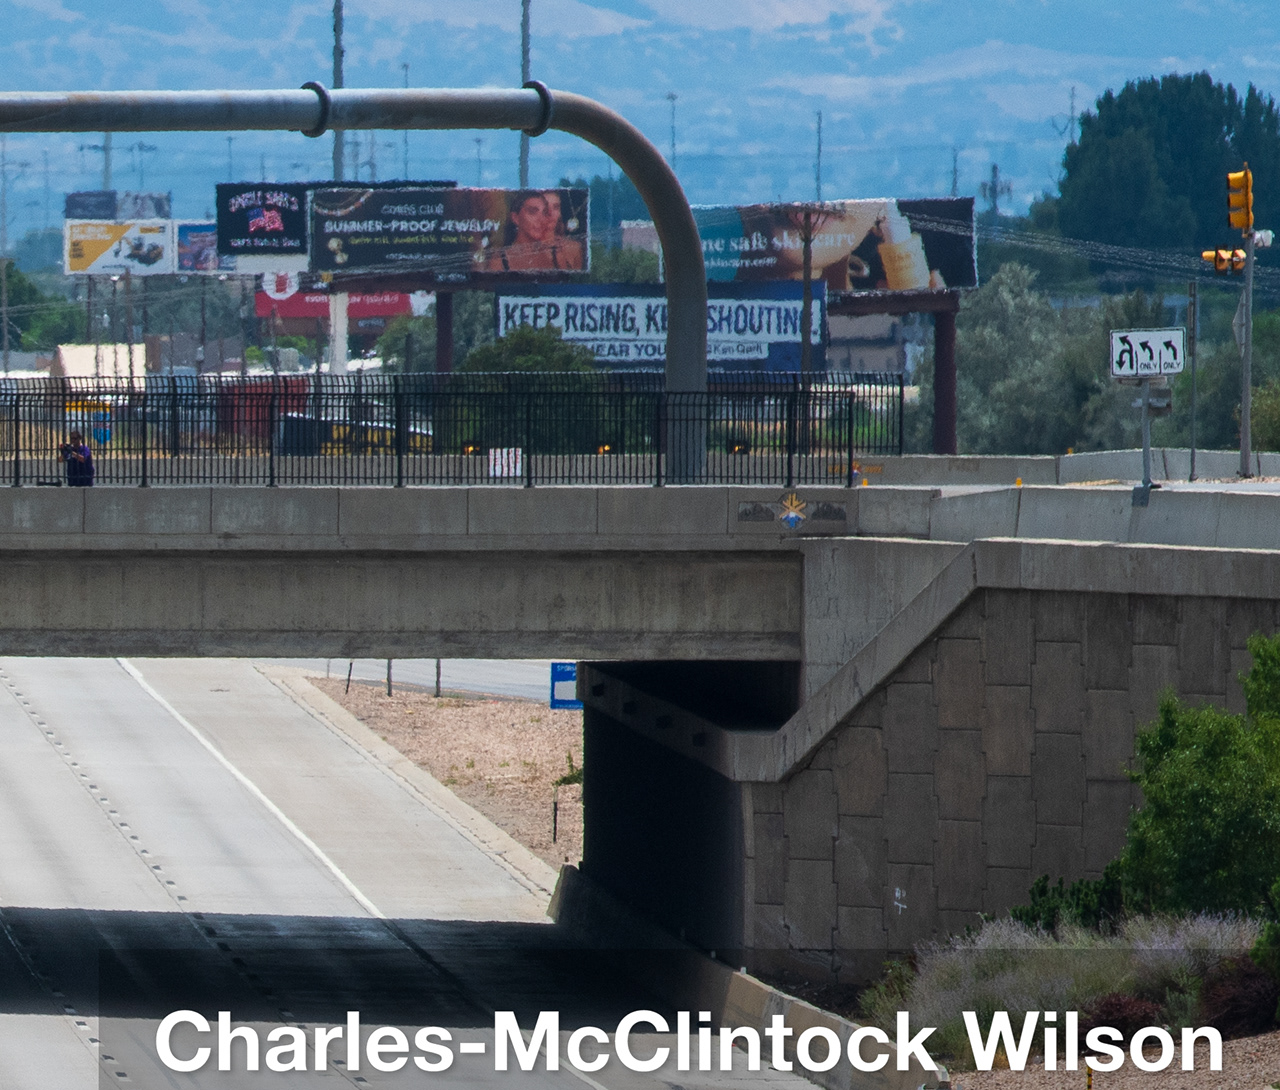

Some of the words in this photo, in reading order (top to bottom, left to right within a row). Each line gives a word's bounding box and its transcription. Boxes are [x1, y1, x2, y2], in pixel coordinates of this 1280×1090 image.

[324, 219, 438, 233] SUMMER-PROOF
[440, 219, 501, 233] JEWELRY
[730, 230, 768, 251] safe
[564, 302, 640, 337] RISING,
[1163, 362, 1181, 370] ONLY
